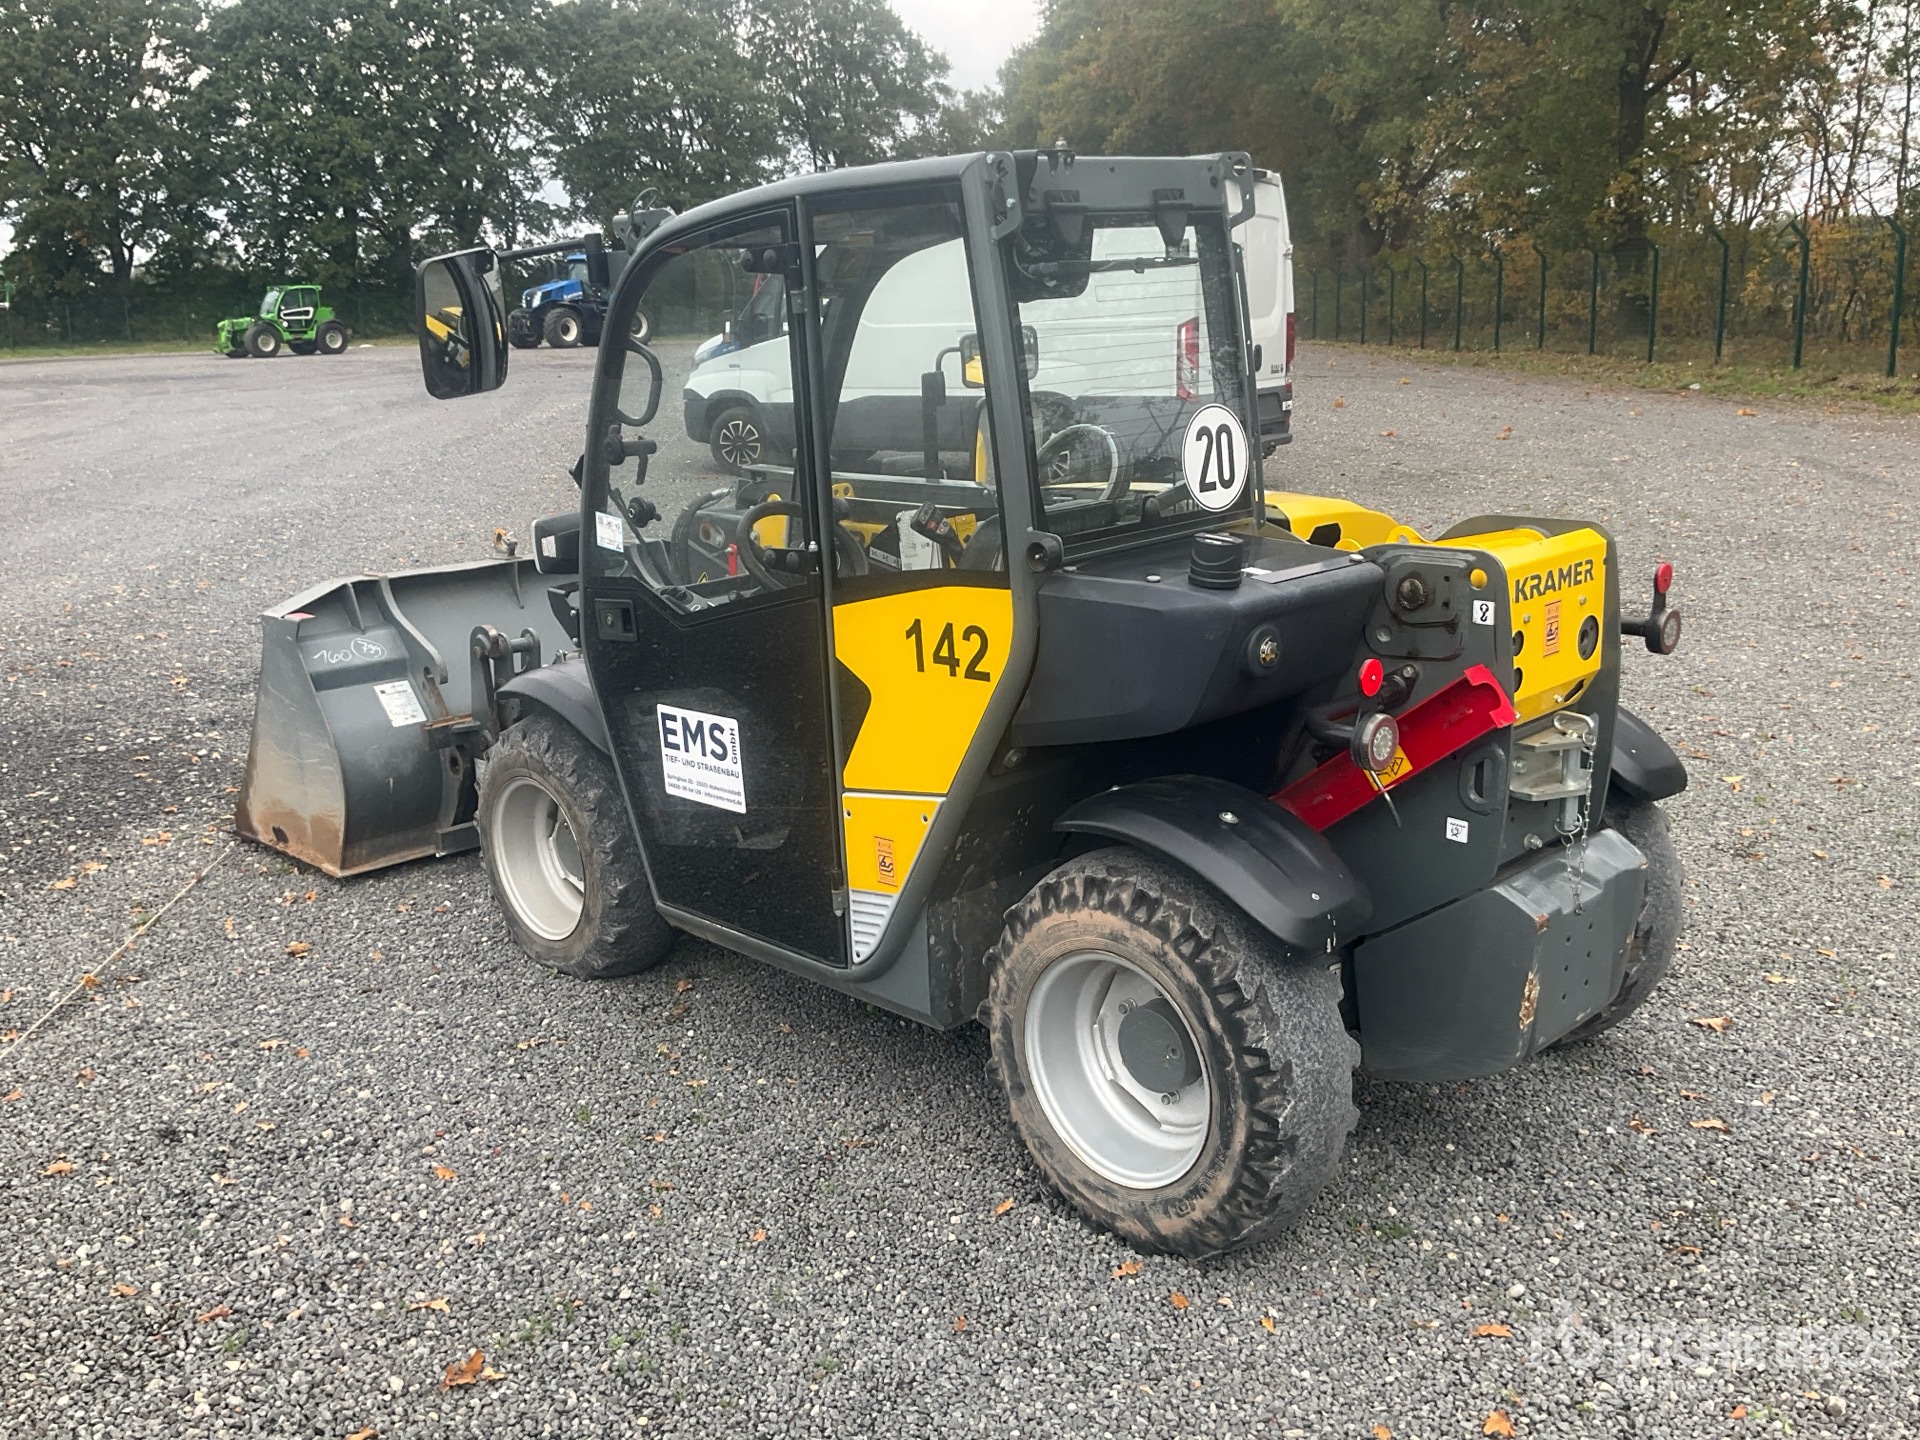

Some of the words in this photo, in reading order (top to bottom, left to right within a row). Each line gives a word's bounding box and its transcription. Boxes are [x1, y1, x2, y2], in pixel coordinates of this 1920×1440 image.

[1195, 423, 1235, 493] 20
[1514, 558, 1594, 604] KRAMER
[313, 649, 352, 664] 160
[905, 618, 991, 682] 142
[660, 711, 729, 762] EMS
[728, 727, 738, 765] GmbH
[664, 753, 680, 763] TIEF-
[681, 758, 696, 768] UND
